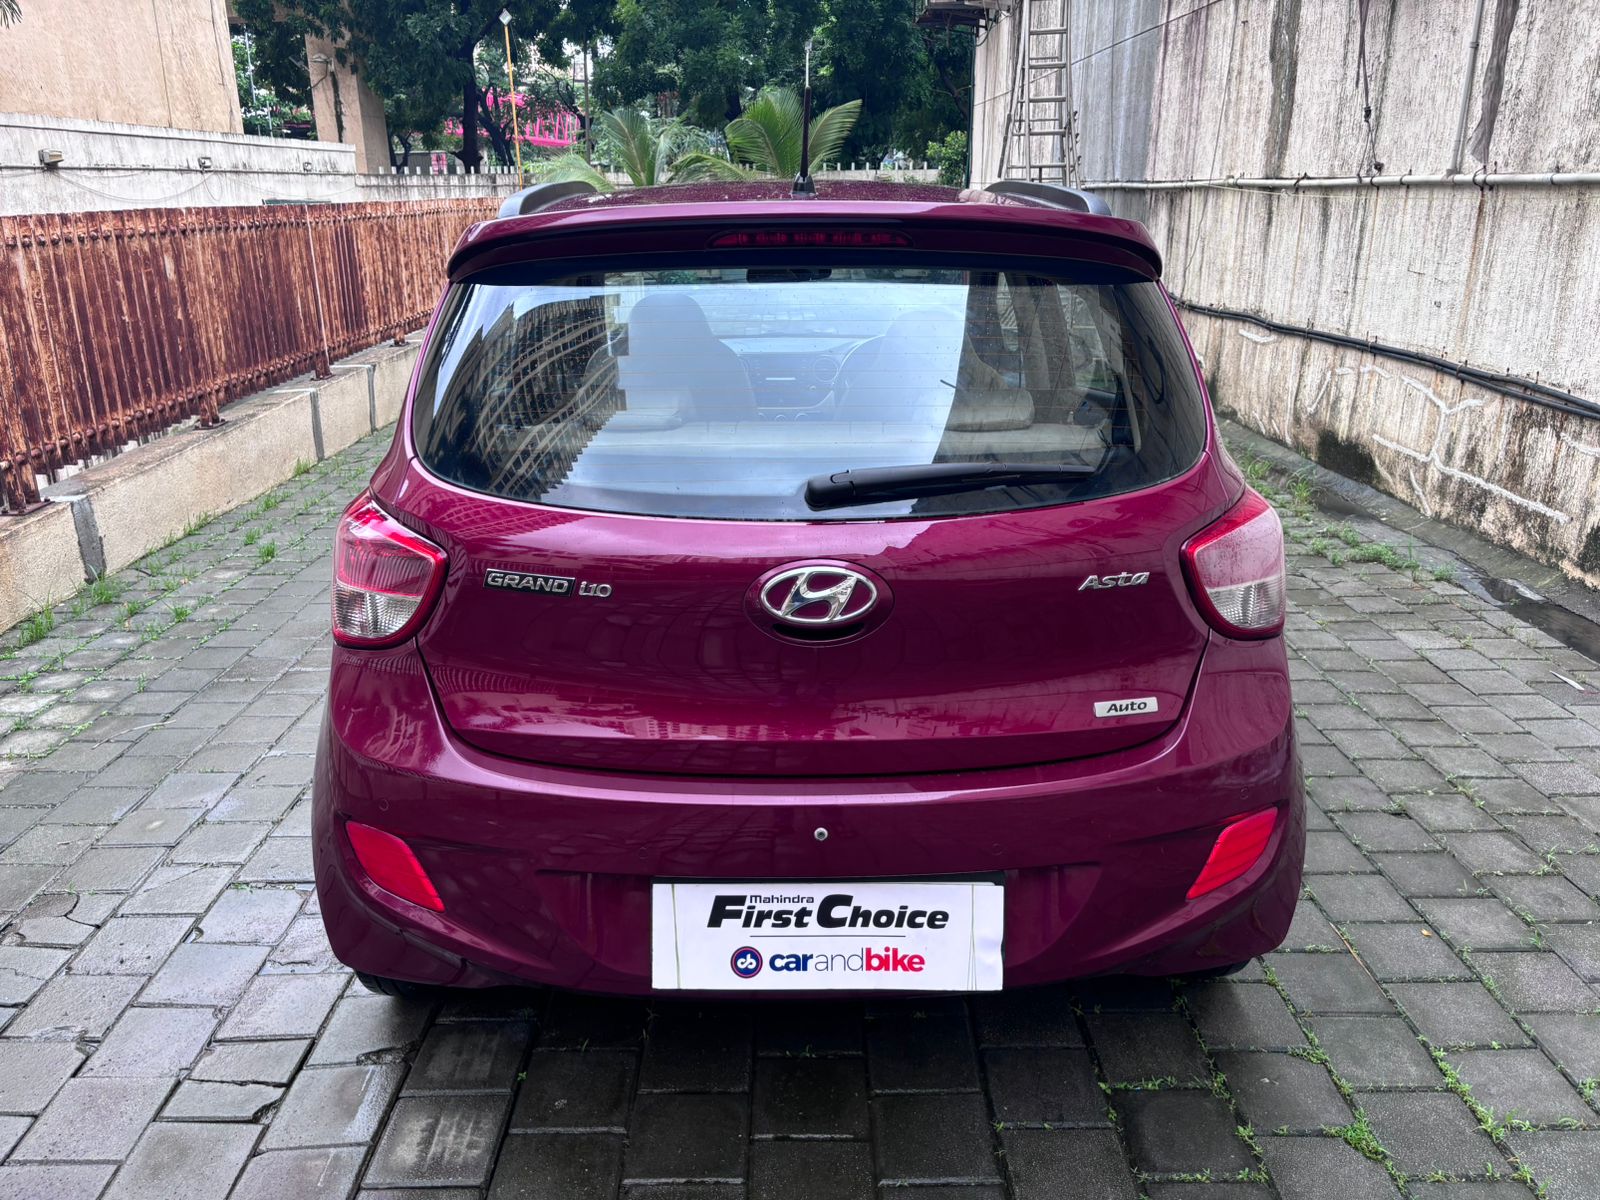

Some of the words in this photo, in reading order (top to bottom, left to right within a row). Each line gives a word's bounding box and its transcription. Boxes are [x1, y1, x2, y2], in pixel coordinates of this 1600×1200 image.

[487, 572, 569, 593] GRAND
[578, 581, 612, 598] i10
[1078, 571, 1150, 591] Asta
[1106, 701, 1147, 714] Auto
[749, 894, 815, 904] Mahindra
[706, 894, 813, 929] First
[816, 894, 950, 929] Choice
[768, 946, 926, 973] carandbike
